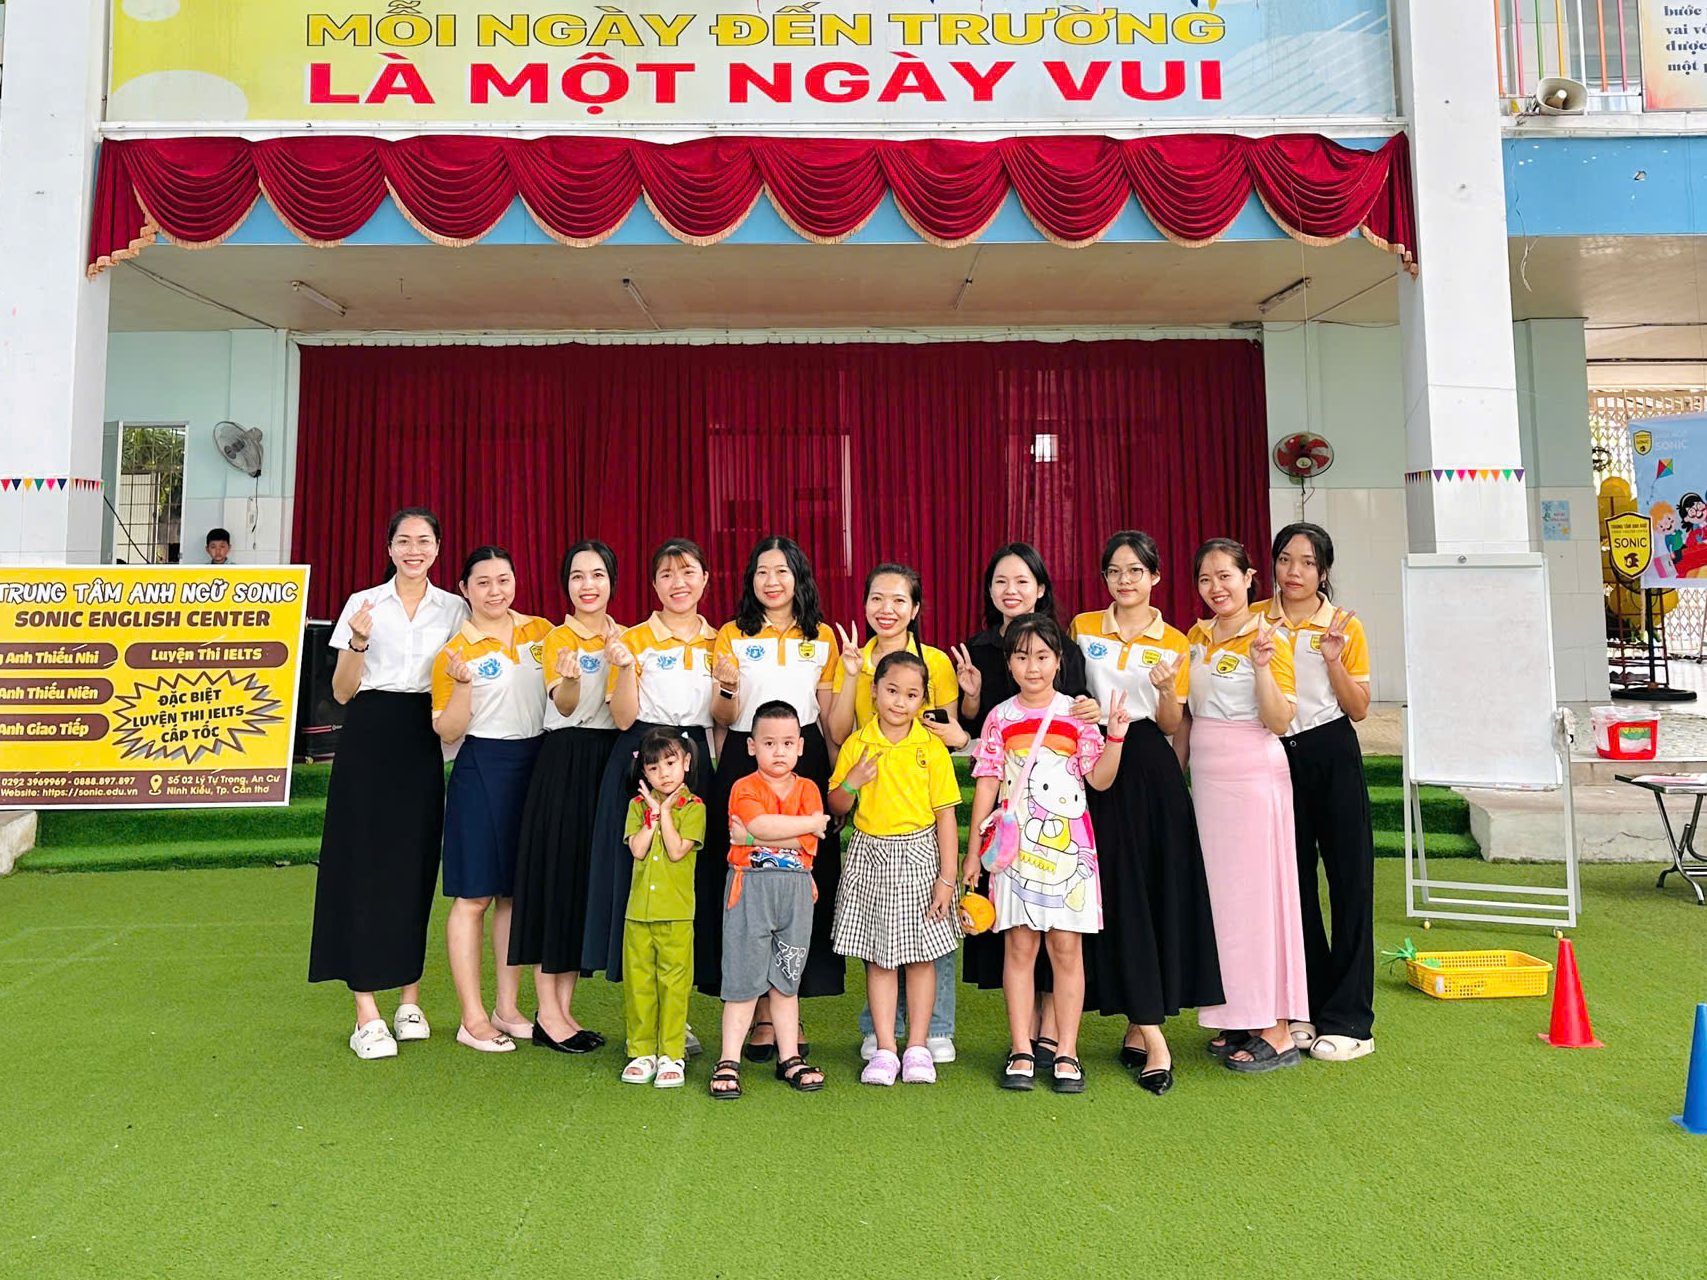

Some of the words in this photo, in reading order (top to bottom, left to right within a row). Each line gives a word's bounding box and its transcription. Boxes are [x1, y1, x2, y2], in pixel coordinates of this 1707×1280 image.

[1664, 5, 1702, 16] bước
[306, 1, 456, 47] MỖI
[477, 6, 697, 47] NGÀY
[709, 2, 871, 46] ĐẾN
[888, 4, 1226, 46] TRƯỜNG
[1665, 24, 1688, 35] vai
[1668, 60, 1699, 75] một
[308, 52, 435, 104] LÀ
[470, 52, 695, 115] MỘT
[729, 51, 1017, 103] NGÀY
[1043, 60, 1222, 101] VUI
[1614, 537, 1647, 548] SONIC
[0, 582, 67, 604] TRUNG
[73, 577, 123, 604] TÂM
[128, 582, 176, 604] ANH
[180, 578, 229, 604] NGỮ
[232, 582, 298, 603] SONIC
[14, 611, 84, 627] SONIC
[88, 611, 181, 627] ENGLISH
[187, 610, 270, 627] CENTER
[5, 651, 33, 664] Anh
[35, 646, 73, 664] Thiếu
[75, 650, 100, 664] Nhi
[151, 647, 194, 664] Luyện
[198, 647, 220, 661] Thi
[223, 647, 262, 661] IELTS
[0, 686, 25, 700] Anh
[27, 681, 65, 699] Thiếu
[66, 685, 99, 699] Niên
[157, 690, 187, 708] ĐẶC
[190, 687, 222, 705] BIỆT
[132, 710, 177, 728] LUYỆN
[181, 710, 204, 723] THI
[208, 705, 245, 720] IELTS
[0, 721, 25, 736] Anh
[26, 721, 58, 736] Giao
[59, 717, 89, 738] Tiếp
[161, 724, 189, 743] CẤP
[191, 720, 220, 740] TỐC
[1, 777, 24, 786] 0292
[26, 777, 67, 786] 3969969
[73, 776, 136, 786] 0888.897.897
[167, 774, 180, 785] Số
[181, 776, 193, 785] 02
[251, 775, 264, 784] An
[1, 788, 40, 797] Website:
[42, 787, 138, 798] https://sonic.edu.vn
[166, 786, 188, 796] Ninh
